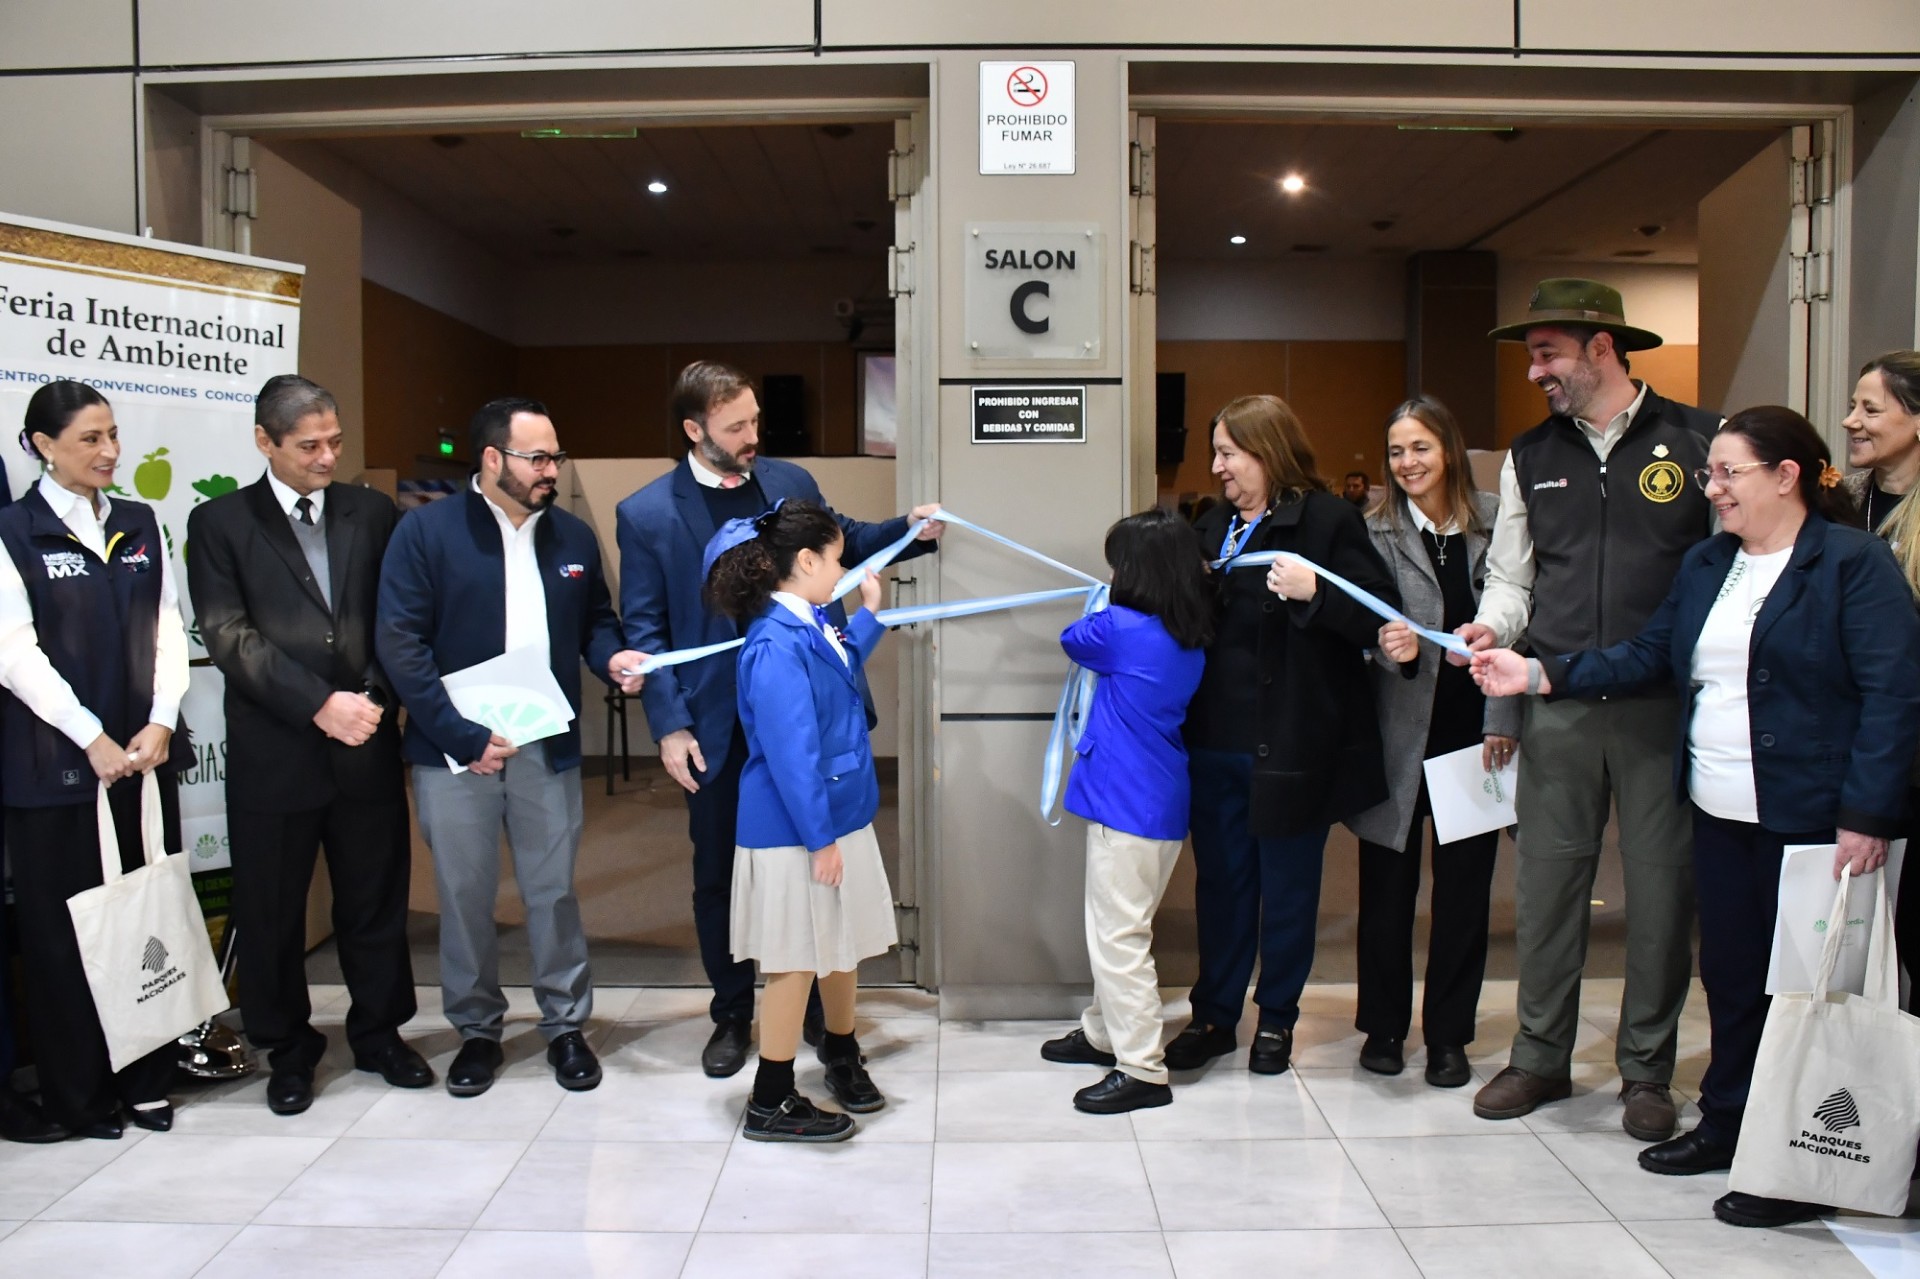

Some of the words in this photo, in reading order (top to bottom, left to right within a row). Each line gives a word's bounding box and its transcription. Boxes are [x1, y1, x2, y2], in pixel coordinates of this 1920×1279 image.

[987, 115, 1068, 126] PROHIBIDO
[1002, 130, 1053, 141] FUMAR
[985, 249, 1076, 270] SALON
[1010, 280, 1049, 334] C
[86, 297, 284, 348] Internacional
[47, 328, 87, 358] de
[98, 335, 248, 376] Ambiente
[978, 397, 1030, 407] PROHIBIDO
[1031, 396, 1079, 406] INGRESAR
[1018, 410, 1039, 419] CON
[982, 423, 1022, 433] BEBIDAS
[1024, 424, 1031, 432] Y
[1033, 423, 1075, 432] COMIDAS
[47, 564, 90, 579] MX
[137, 971, 187, 1004] NACIONALES
[142, 966, 178, 991] PARQUES
[1801, 1130, 1862, 1150] PARQUES
[1789, 1139, 1871, 1164] NACIONALES
